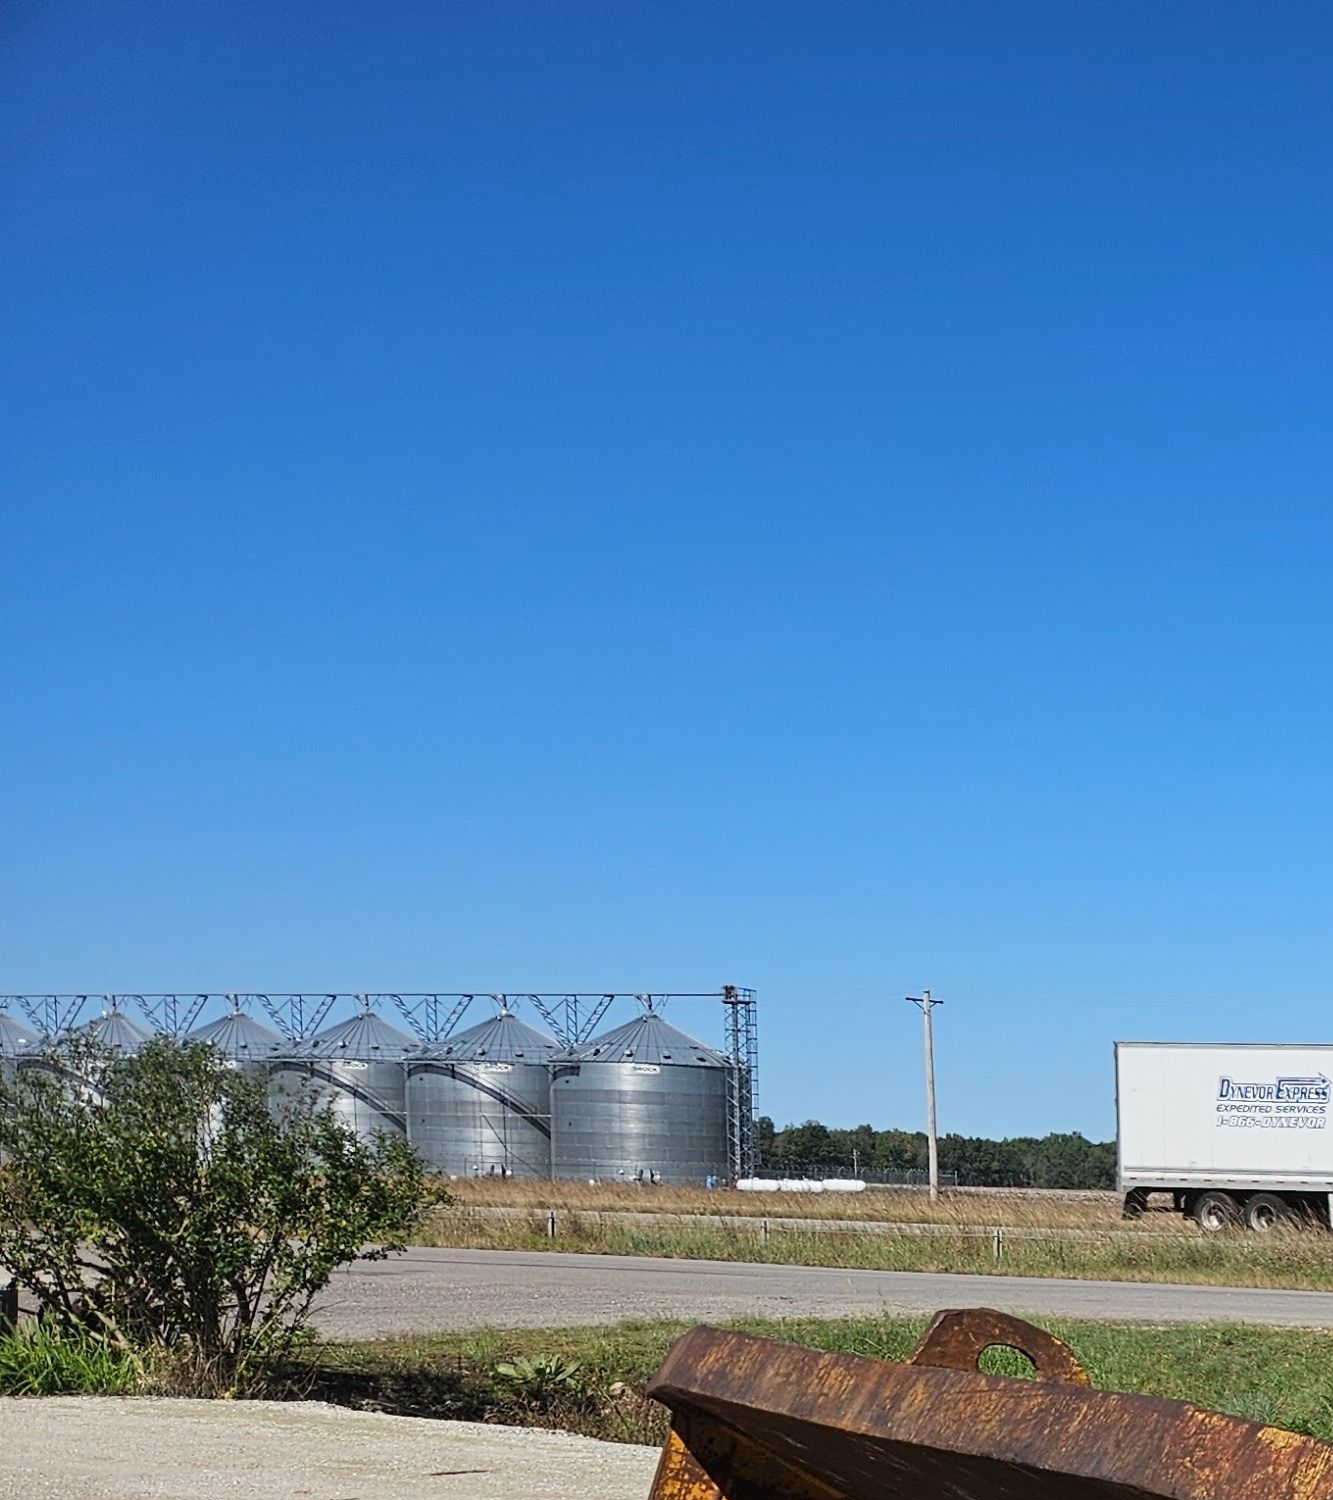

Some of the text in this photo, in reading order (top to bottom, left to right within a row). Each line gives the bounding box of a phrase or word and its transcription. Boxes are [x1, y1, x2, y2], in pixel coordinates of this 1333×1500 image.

[1219, 1078, 1328, 1100] DYNEVOR EXPRESS
[1216, 1104, 1326, 1114] EXPEDITED SERVICES
[1216, 1116, 1326, 1129] 1-866-DYNEVOR
